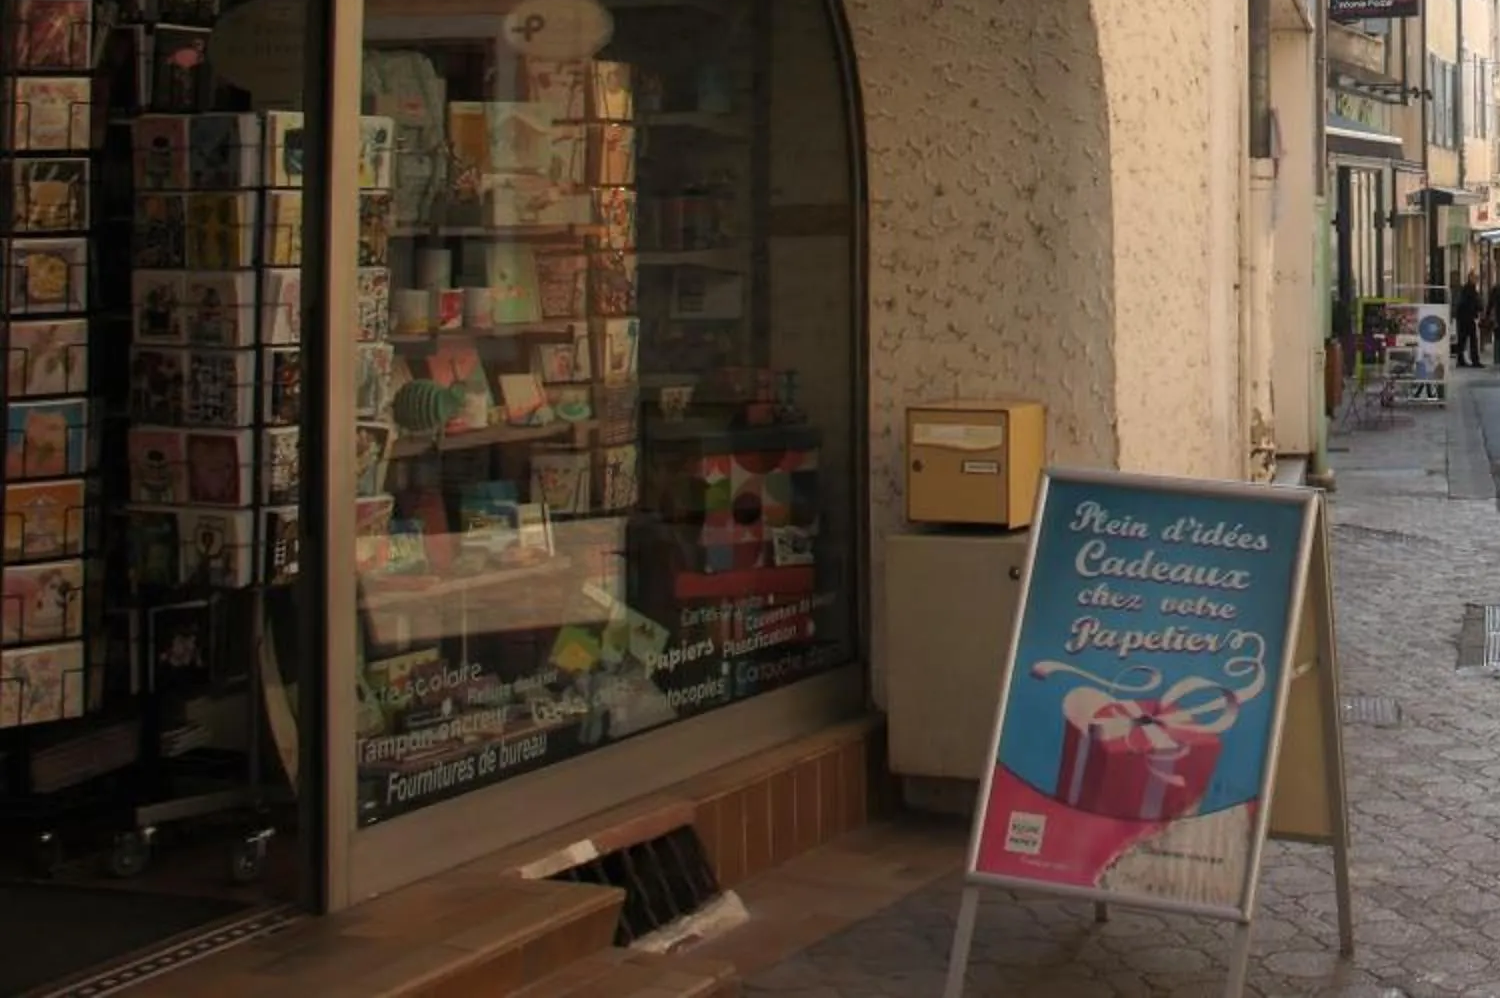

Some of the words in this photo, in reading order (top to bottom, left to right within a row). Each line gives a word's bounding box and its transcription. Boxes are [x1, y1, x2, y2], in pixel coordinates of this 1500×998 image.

[1069, 501, 1149, 540] Plein
[1161, 516, 1271, 551] d'idées
[1075, 539, 1252, 590] Cadeaux
[1077, 582, 1144, 612] chez
[1160, 594, 1238, 620] votre
[1065, 615, 1222, 657] Papetier
[386, 754, 476, 806] Fournitures
[478, 750, 498, 776] de
[499, 733, 548, 770] bureau
